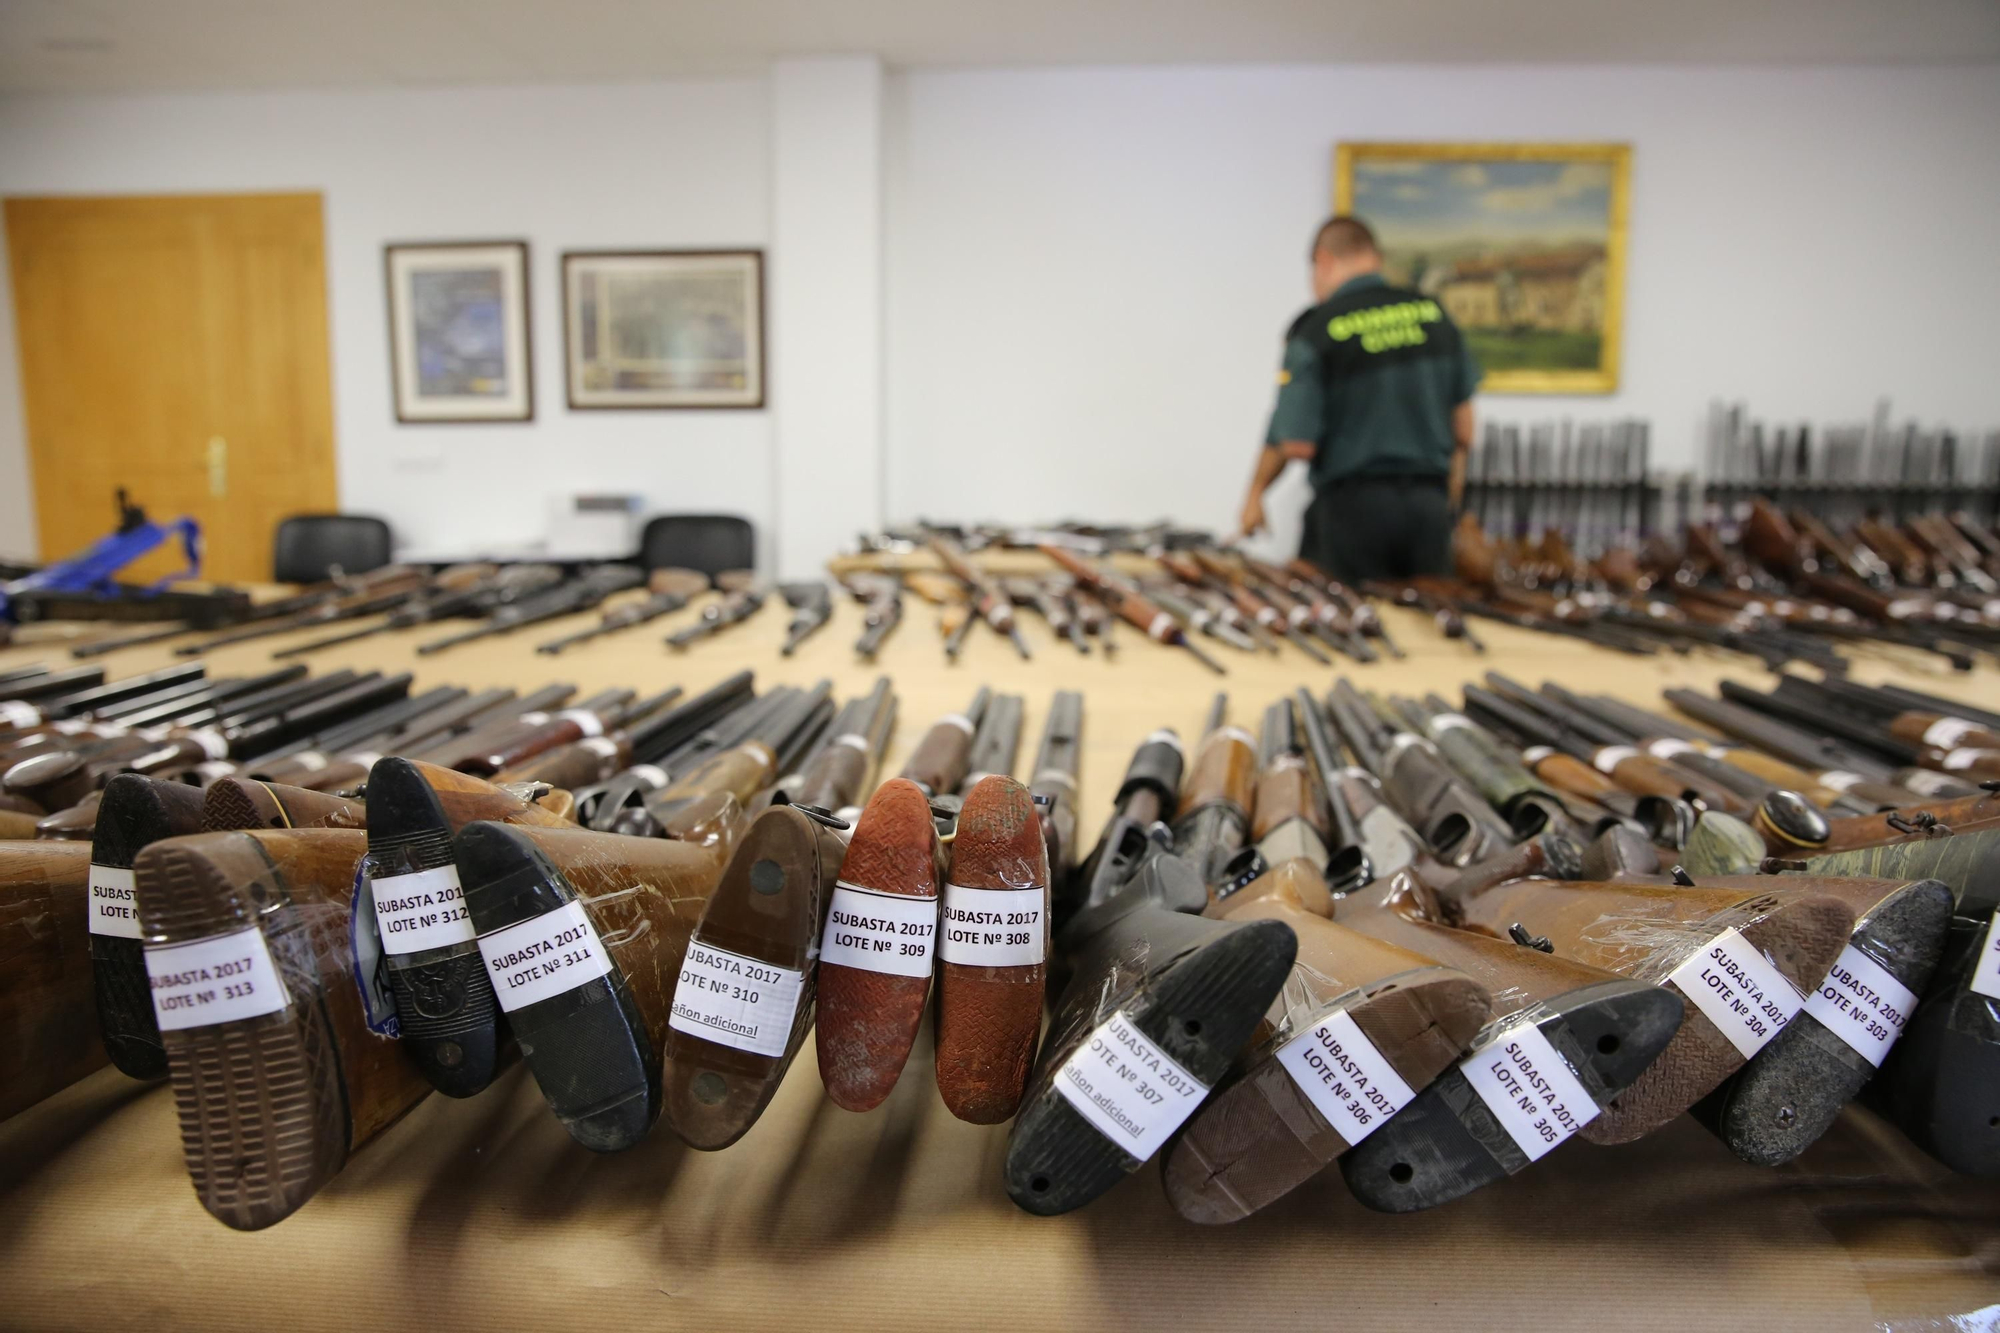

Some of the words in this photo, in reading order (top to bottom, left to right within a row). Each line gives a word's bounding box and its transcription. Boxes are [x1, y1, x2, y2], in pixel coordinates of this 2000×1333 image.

[94, 886, 138, 901] SUBAST
[101, 905, 129, 918] LOTE
[377, 894, 434, 913] SUBASTA
[436, 887, 465, 903] 201
[387, 918, 417, 933] LOTE
[420, 914, 437, 928] Nº
[442, 907, 469, 923] 312
[832, 911, 896, 933] SUBASTA
[899, 922, 933, 937] 2017
[945, 906, 1003, 925] SUBASTA
[1006, 911, 1039, 925] 2017
[492, 940, 554, 971] SUBASTA
[554, 923, 588, 947] 2017
[835, 932, 870, 950] LOTE
[873, 939, 892, 953] Nº
[899, 943, 926, 957] 309
[947, 928, 980, 944] LOTE
[984, 933, 1002, 945] Nº
[1006, 932, 1030, 945] 308
[213, 958, 252, 978] 2017
[507, 967, 541, 988] LOTE
[542, 959, 561, 975] Nº
[564, 947, 592, 967] 311
[687, 946, 741, 975] UBASTA
[745, 965, 782, 985] 2017
[160, 995, 194, 1011] LOTE
[224, 982, 254, 999] 313
[679, 970, 707, 989] OTE
[710, 980, 729, 994] Nº
[731, 986, 759, 1004] 310
[1700, 968, 1734, 1001] LOTE
[1730, 998, 1749, 1016] Nº
[1745, 1015, 1767, 1038] 304
[1710, 948, 1764, 1004] SUBASTA
[1761, 1000, 1788, 1027] 2017
[1830, 965, 1880, 1009] UBASTA
[1879, 1003, 1907, 1028] 2017
[672, 1002, 701, 1020] añon
[703, 1014, 758, 1036] adicional
[1816, 981, 1851, 1012] LOTE
[1849, 1006, 1868, 1023] Nº
[1865, 1020, 1888, 1041] 303
[1089, 1038, 1119, 1067] OTE
[1116, 1064, 1138, 1083] Nº
[1135, 1081, 1164, 1106] 307
[1107, 1019, 1161, 1073] UBASTA
[1160, 1068, 1196, 1098] 2017
[1315, 1027, 1368, 1089] SUBASTA
[1365, 1086, 1396, 1115] 2017
[1303, 1048, 1336, 1084] LOTE
[1331, 1082, 1351, 1101] Nº
[1346, 1100, 1372, 1125] 306
[1490, 1061, 1523, 1098] LOTE
[1517, 1096, 1537, 1115] Nº
[1534, 1118, 1558, 1143] 305
[1505, 1043, 1556, 1105] SUBASTA
[1552, 1103, 1580, 1133] 2017
[1094, 1092, 1146, 1136] adicional
